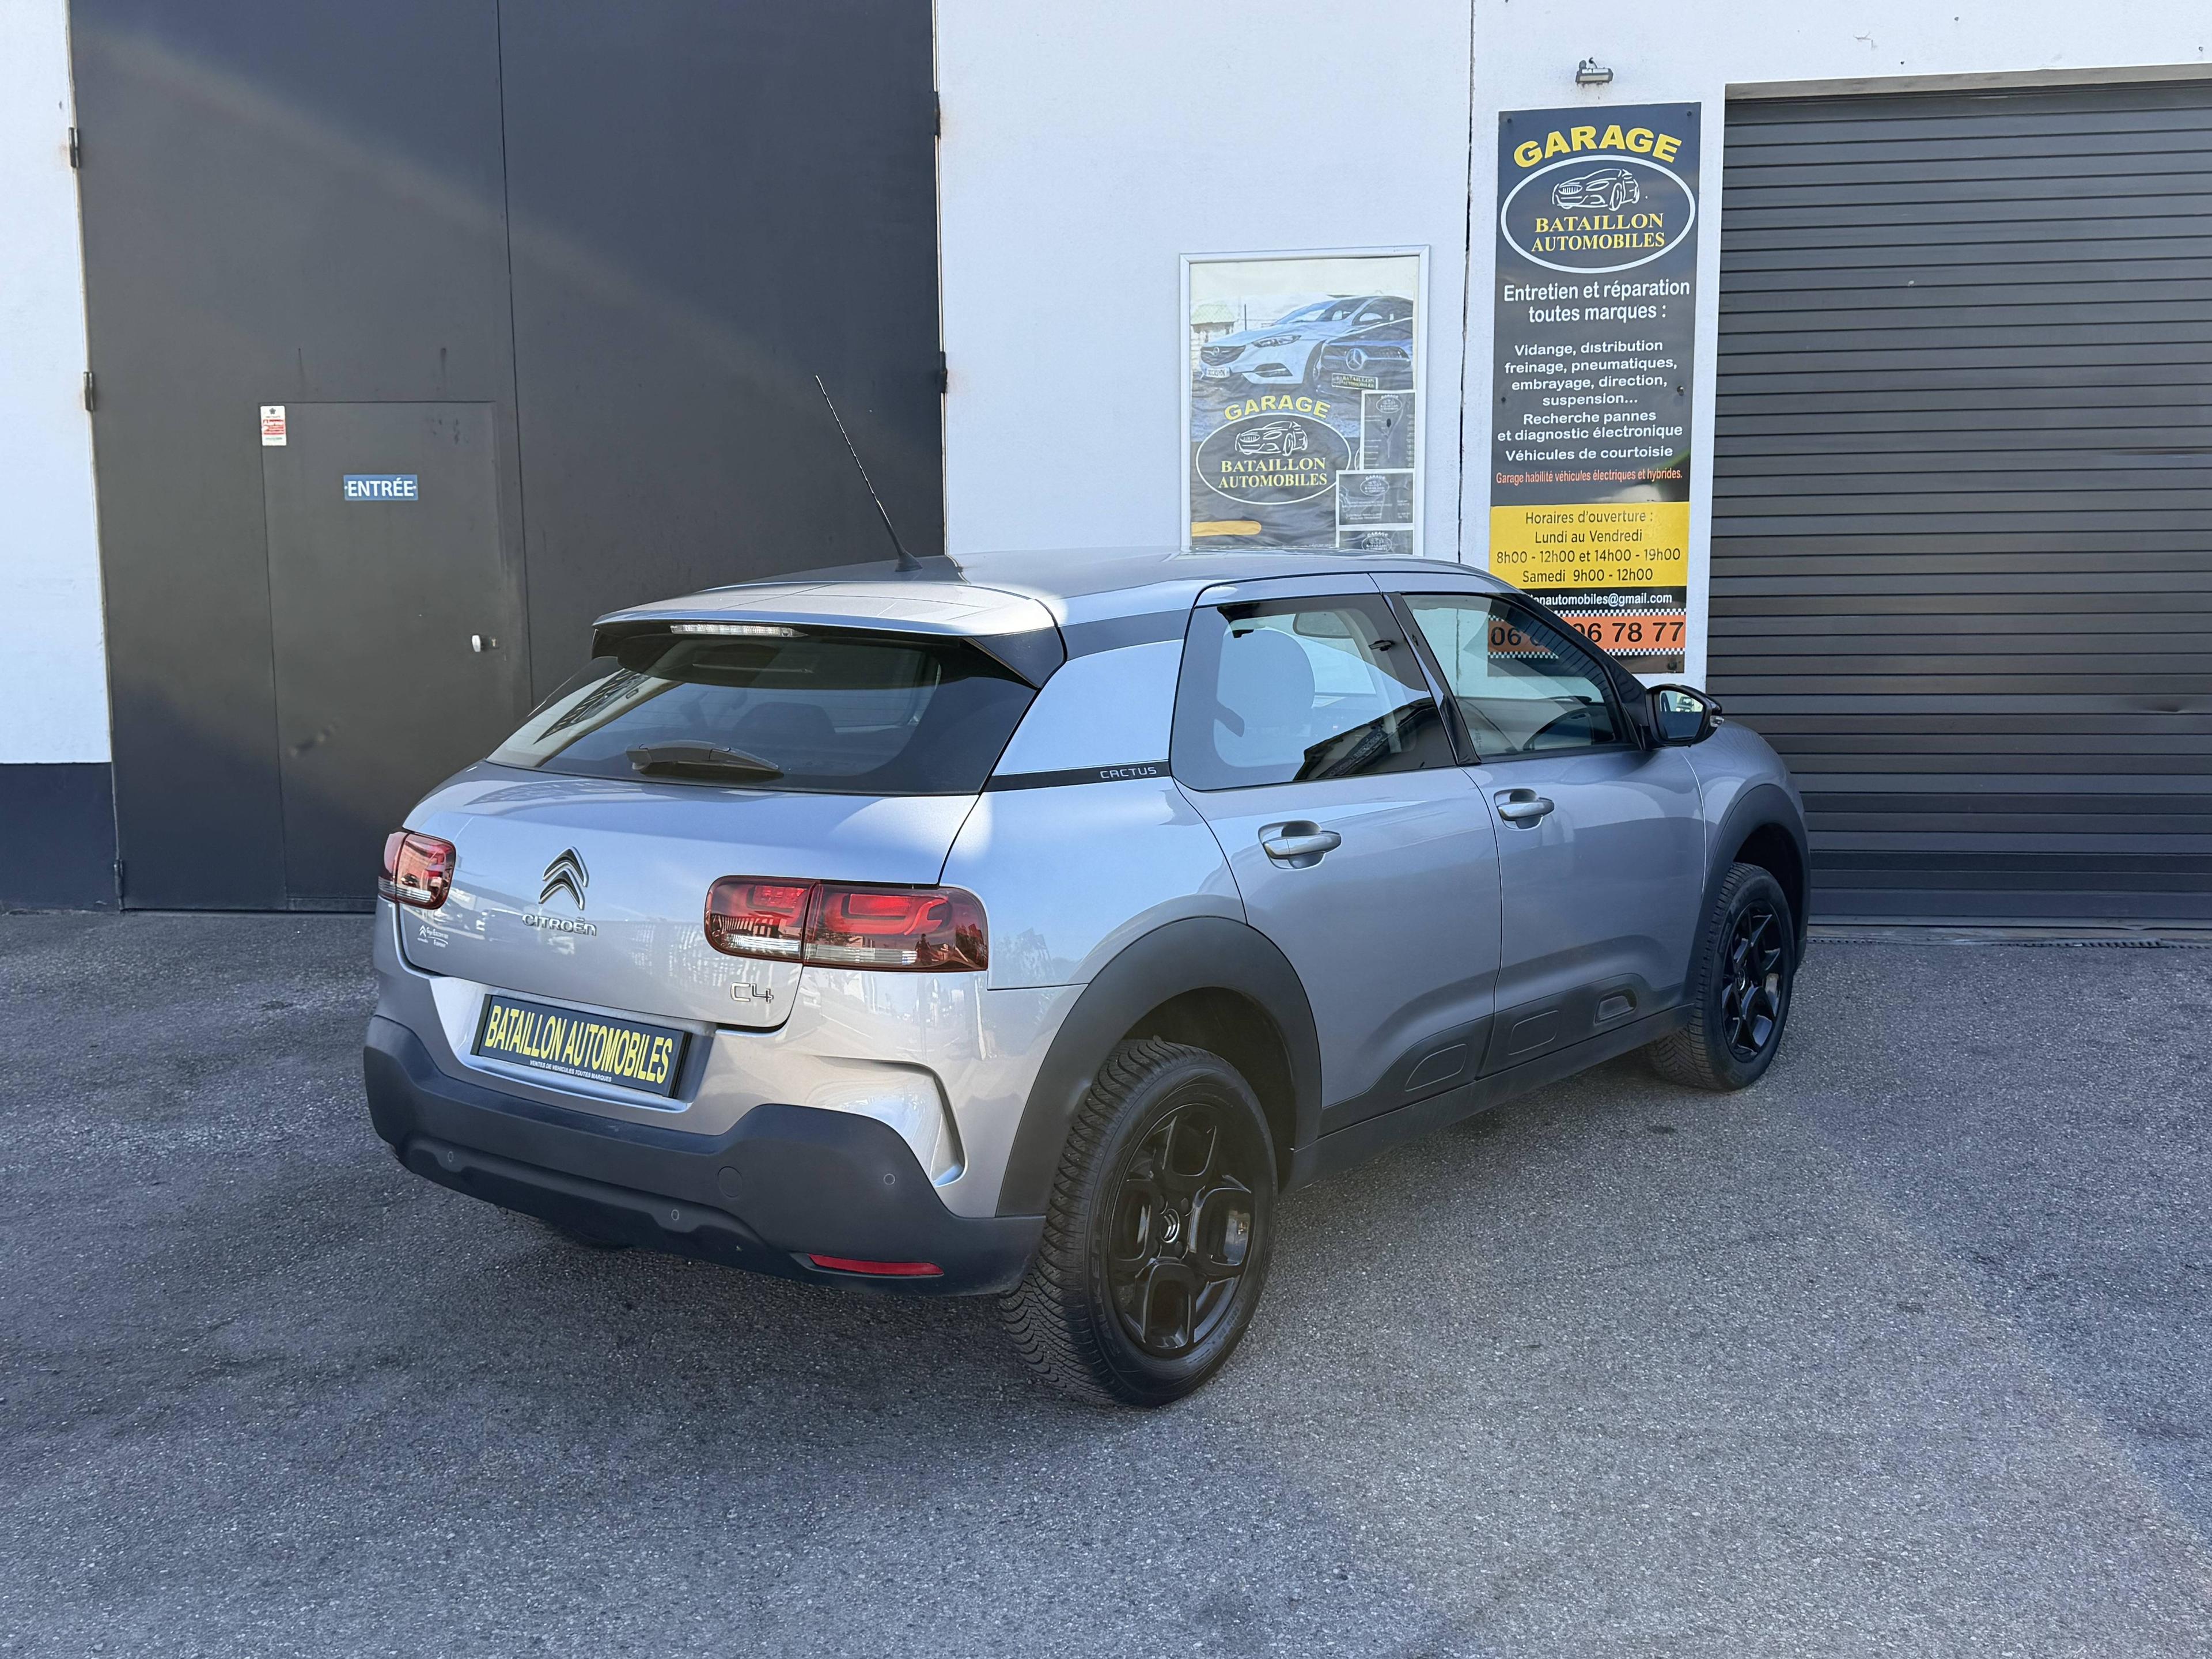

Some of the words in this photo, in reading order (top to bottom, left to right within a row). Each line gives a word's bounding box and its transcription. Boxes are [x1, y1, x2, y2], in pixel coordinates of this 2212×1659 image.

[1513, 124, 1682, 168] GARAGE
[1535, 213, 1664, 233] BATAILLON
[1531, 232, 1665, 252] AUTOMOBILES
[1503, 284, 1578, 301] Entretien
[1583, 282, 1600, 298] et
[1604, 279, 1690, 301] réparation
[1528, 305, 1580, 323] toutes
[1585, 305, 1657, 323] marques
[1514, 344, 1577, 357] Vidange,
[1580, 340, 1663, 354] distribution
[1504, 362, 1567, 375] freinage,
[1571, 358, 1677, 374] pneumatiques,
[1512, 378, 1594, 392] embrayage,
[1599, 374, 1668, 388] direction,
[1224, 395, 1331, 421] GARAGE
[1542, 393, 1638, 408] suspension...
[1523, 412, 1600, 425] Recherche
[1604, 411, 1657, 425] pannes
[1497, 430, 1512, 441] et
[1515, 428, 1589, 442] diagnostic
[1593, 425, 1683, 439] électronique
[1506, 449, 1575, 461] Véhicules
[1578, 448, 1597, 459] de
[1600, 445, 1673, 459] courtoisie
[1221, 457, 1326, 473] BATAILLON
[1218, 473, 1328, 488] AUTOMOBILES
[1496, 472, 1524, 486] Garage
[1525, 471, 1553, 483] habilité
[1555, 469, 1591, 482] véhicules
[1593, 469, 1637, 482] électriques
[1638, 470, 1646, 479] et
[1647, 467, 1683, 482] hybrides.
[347, 477, 414, 497] ENTRÉE
[1525, 512, 1574, 525] Horaires
[1578, 510, 1646, 523] d'ouverture
[1535, 531, 1567, 543] Lundi
[1571, 533, 1585, 543] au
[1589, 529, 1643, 543] Vendredi
[1497, 551, 1528, 564] 8h00
[1540, 550, 1575, 563] 12h00
[1579, 551, 1590, 562] et
[1595, 548, 1631, 562] 14h00
[1644, 548, 1681, 561] 19h00
[1522, 569, 1566, 583] Samedi
[1573, 569, 1605, 582] 9h00
[1618, 568, 1653, 581] 12h00
[1490, 627, 1522, 646] 06
[1612, 622, 1643, 642] 78
[1652, 622, 1684, 642] 77
[1100, 767, 1157, 778] CACTUS
[522, 914, 597, 936] CITROËN
[730, 982, 774, 1003] C4
[484, 1005, 567, 1061] BATAILLON
[561, 1020, 673, 1084] AUTOMOBILES
